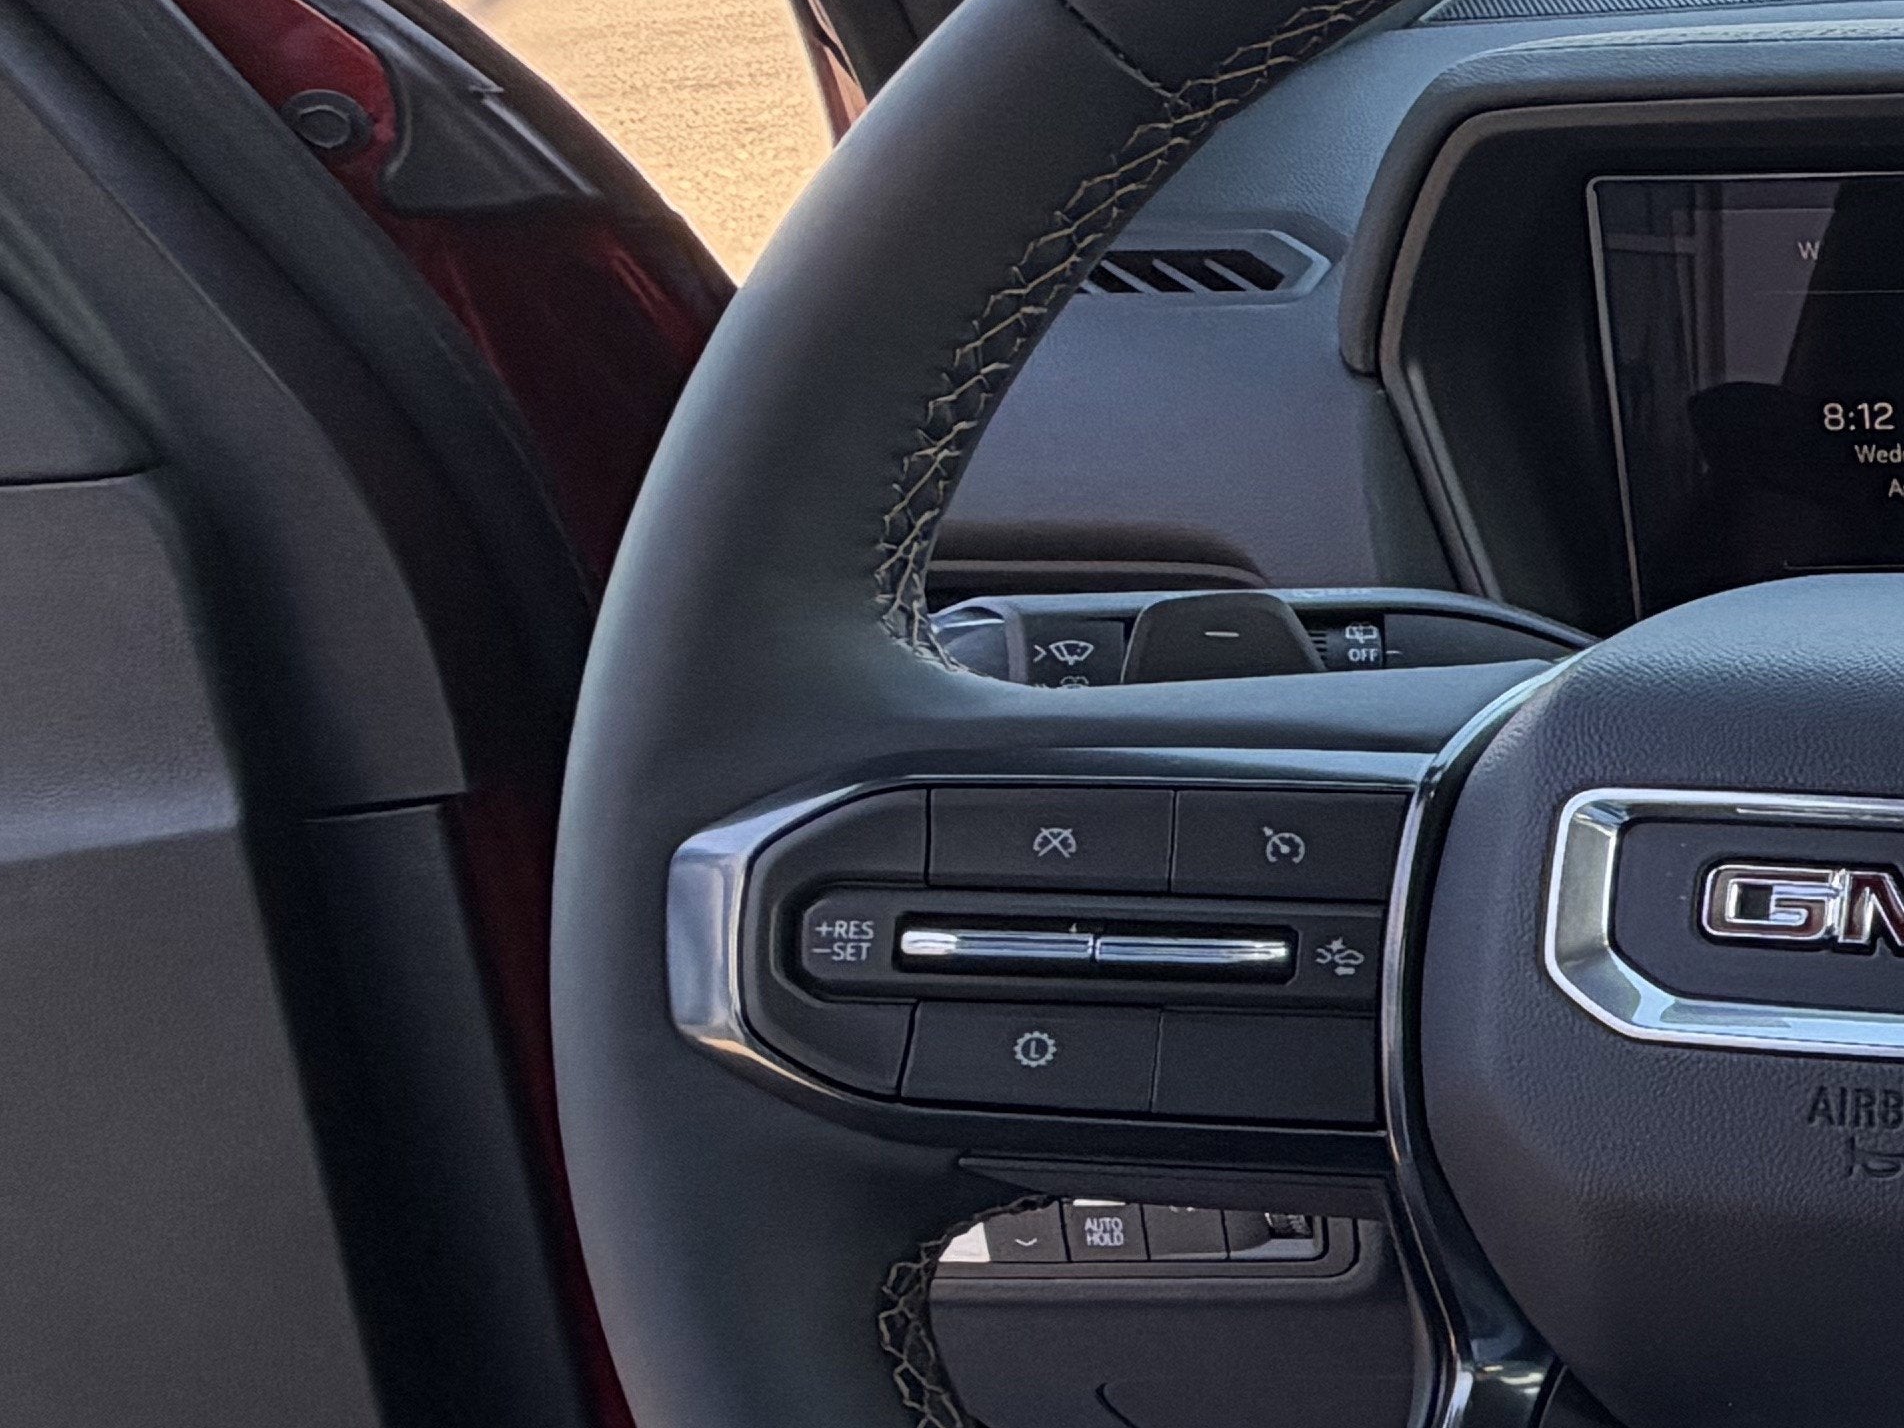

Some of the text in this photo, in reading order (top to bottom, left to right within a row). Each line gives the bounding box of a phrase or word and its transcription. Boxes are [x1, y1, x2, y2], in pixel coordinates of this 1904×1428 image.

[1822, 402, 1896, 432] 8:12
[1347, 647, 1378, 663] OFF
[1084, 1217, 1124, 1233] AUTO
[1085, 1231, 1124, 1248] HOLD
